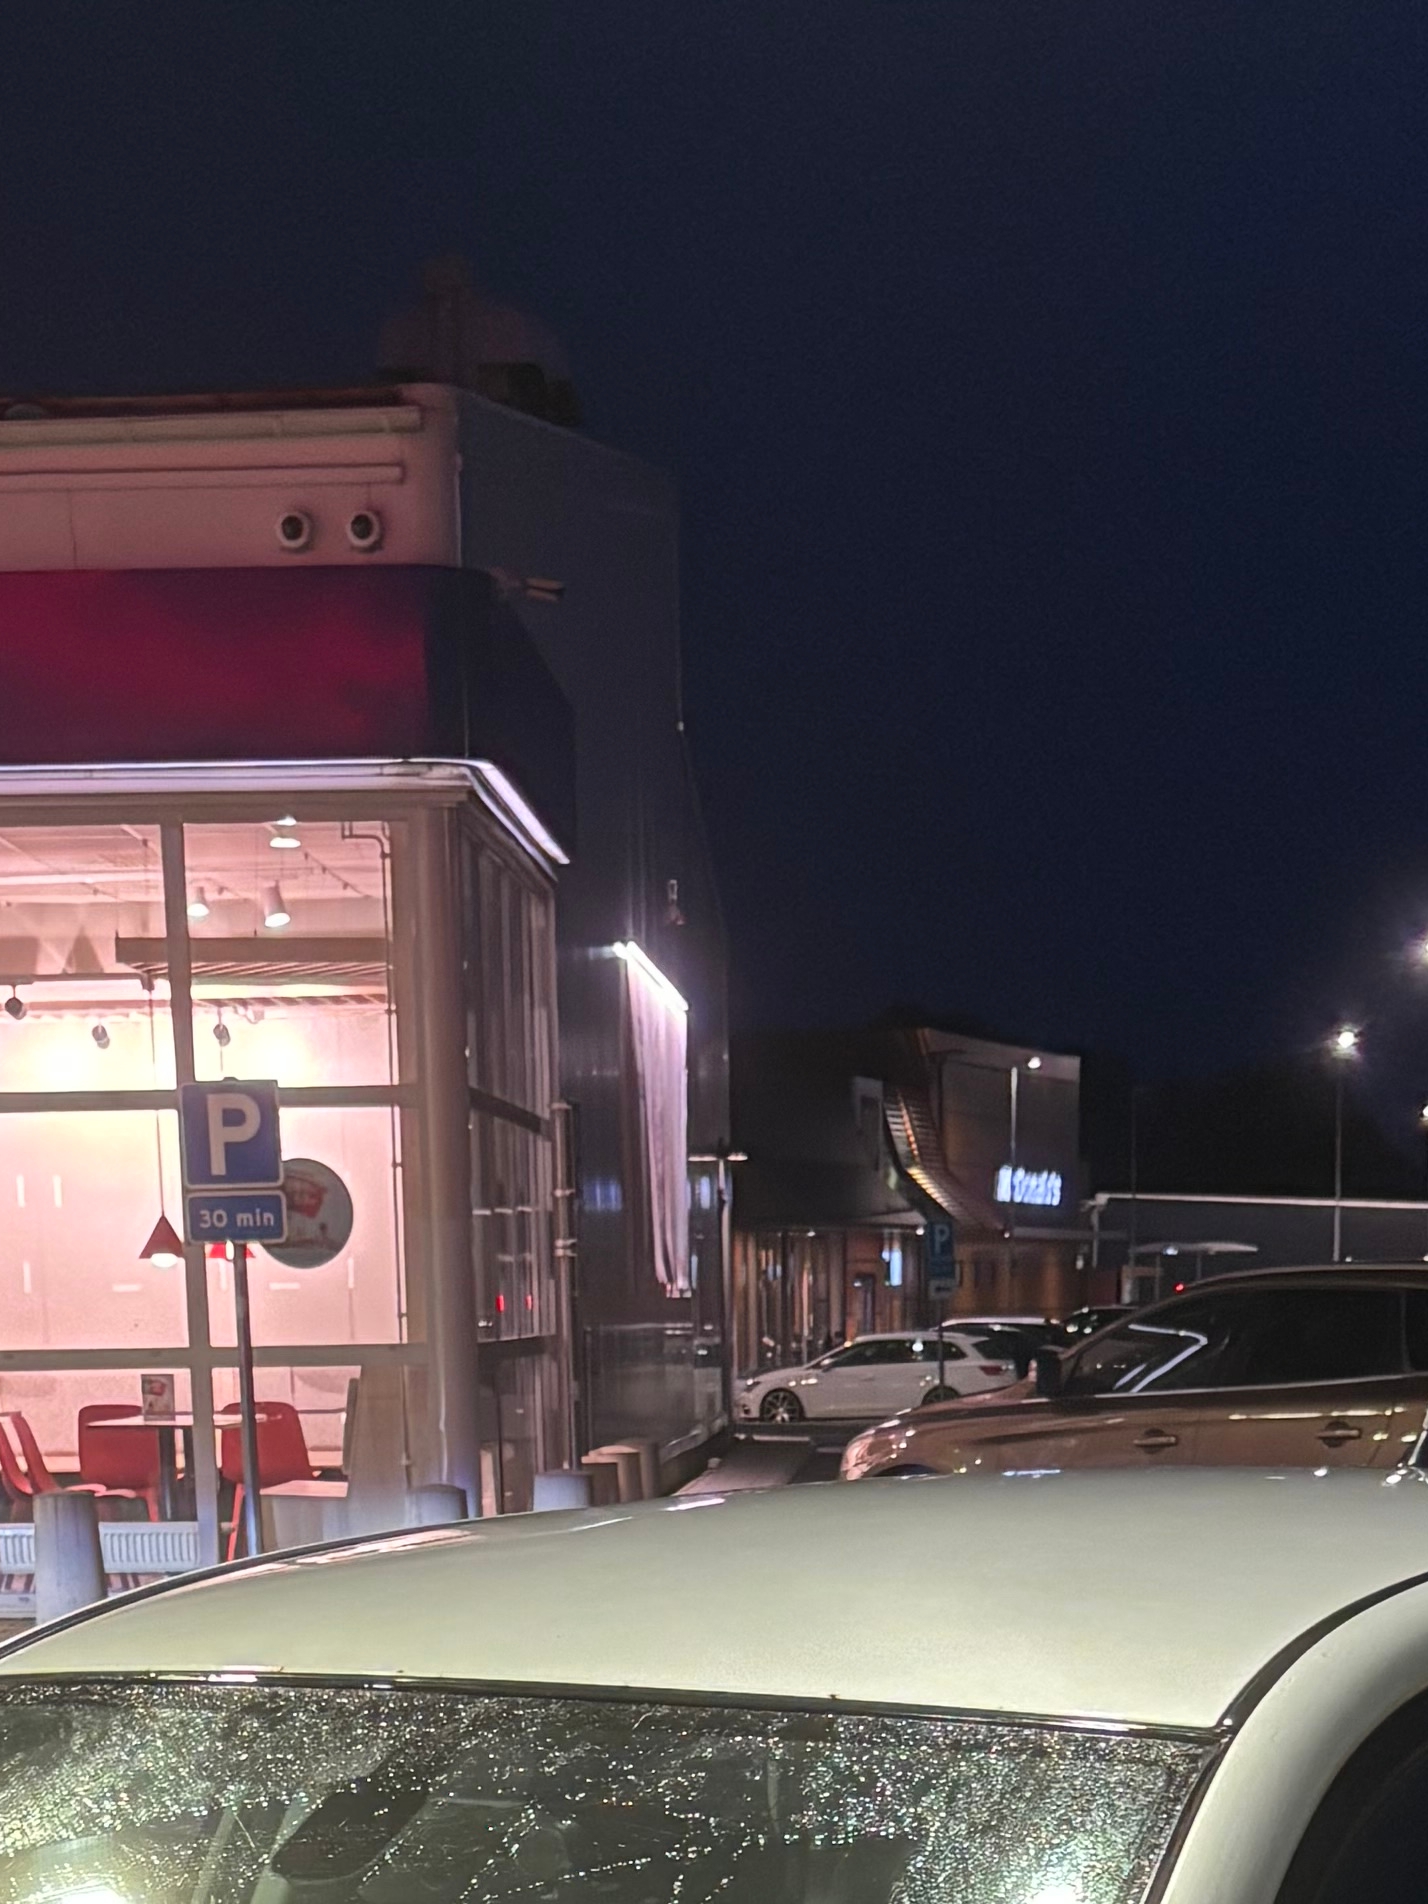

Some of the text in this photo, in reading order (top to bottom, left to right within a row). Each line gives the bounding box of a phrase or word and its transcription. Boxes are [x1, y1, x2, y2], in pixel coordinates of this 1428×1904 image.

[205, 1092, 262, 1176] P
[198, 1207, 276, 1229] 30 min
